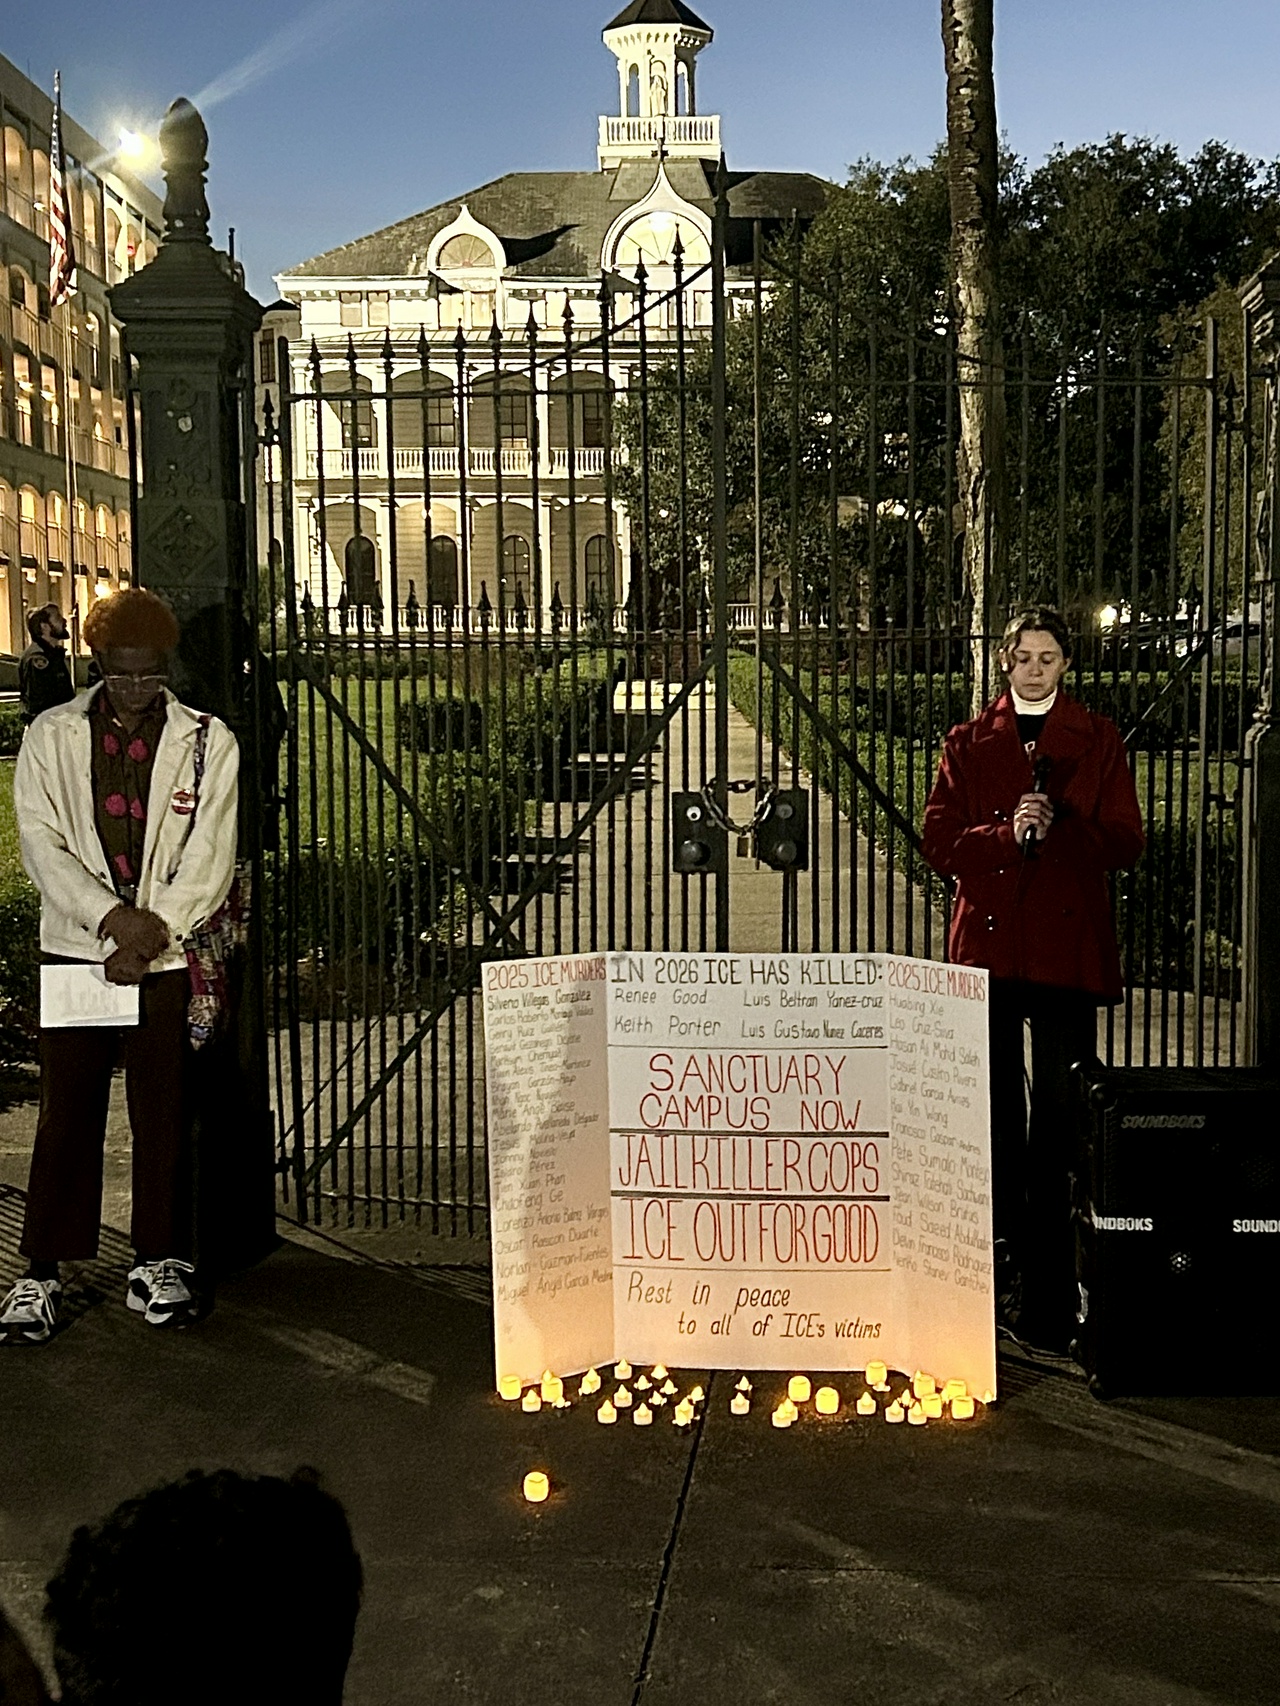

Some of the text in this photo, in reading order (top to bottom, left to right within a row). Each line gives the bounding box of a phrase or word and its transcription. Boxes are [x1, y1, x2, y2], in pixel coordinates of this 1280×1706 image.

[487, 957, 606, 991] 2025 ICE MURDERS
[610, 956, 883, 985] IN 2026 ICE HAS KILLED:
[888, 961, 986, 1002] 2025 ICE MURDERS
[615, 987, 708, 1005] Renee Good
[743, 990, 771, 1007] Luis
[615, 1014, 721, 1037] Keith Porter
[741, 1019, 766, 1039] Luis
[649, 1053, 847, 1095] SANCTUARY
[639, 1092, 862, 1131] CAMPUS NOW
[1120, 1115, 1206, 1129] SOUNDBOKS
[619, 1134, 879, 1193] JAIL KILLER COPS
[891, 1136, 913, 1163] Pete
[621, 1198, 879, 1263] ICE OUT FOR GOOD
[627, 1270, 791, 1316] Rest in peace
[678, 1310, 697, 1335] to
[710, 1313, 732, 1336] all
[752, 1313, 773, 1337] of
[835, 1316, 882, 1339] victims
